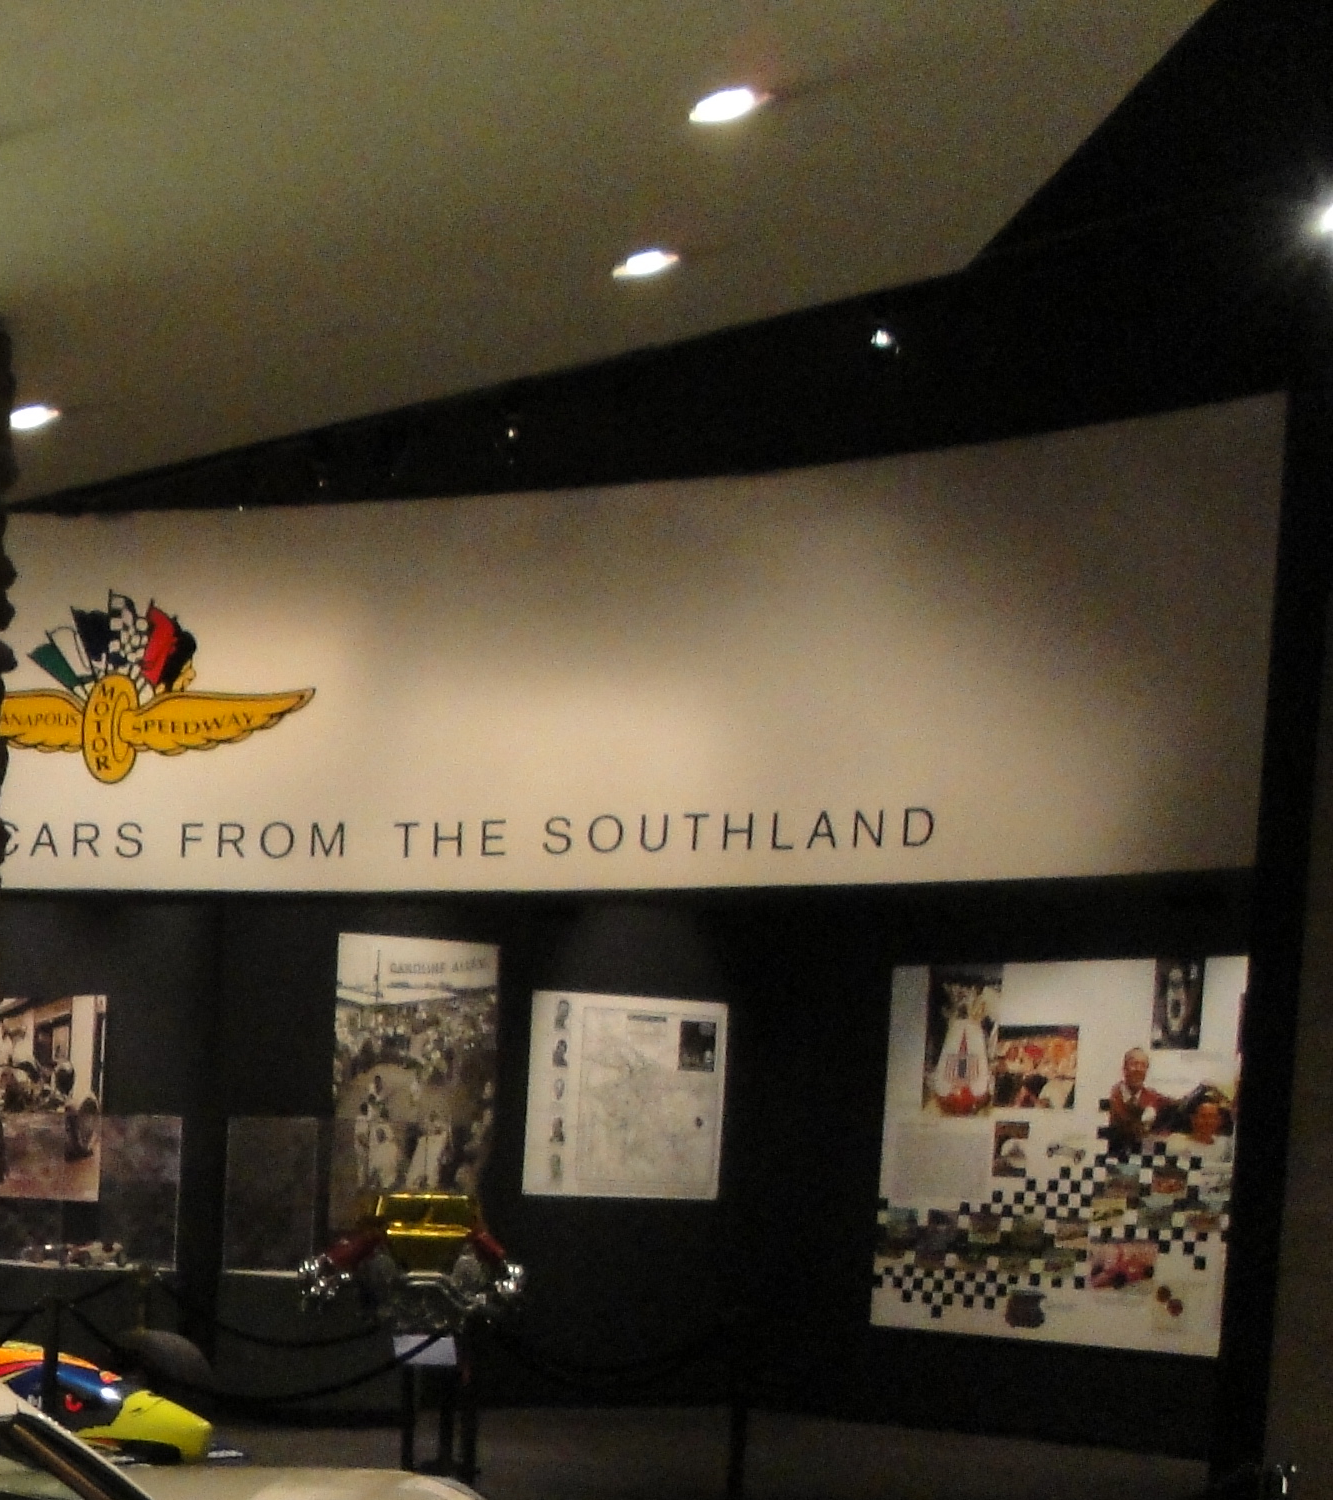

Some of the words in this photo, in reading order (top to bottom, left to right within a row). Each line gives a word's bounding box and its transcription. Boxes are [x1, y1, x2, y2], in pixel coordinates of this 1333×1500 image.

[1, 711, 78, 728] ANAPOLIS
[93, 684, 115, 770] MOTOR
[131, 711, 255, 735] SPEEDWAY
[180, 820, 345, 859] FROM
[394, 819, 507, 857] THE
[542, 807, 934, 855] SOUTHLAND
